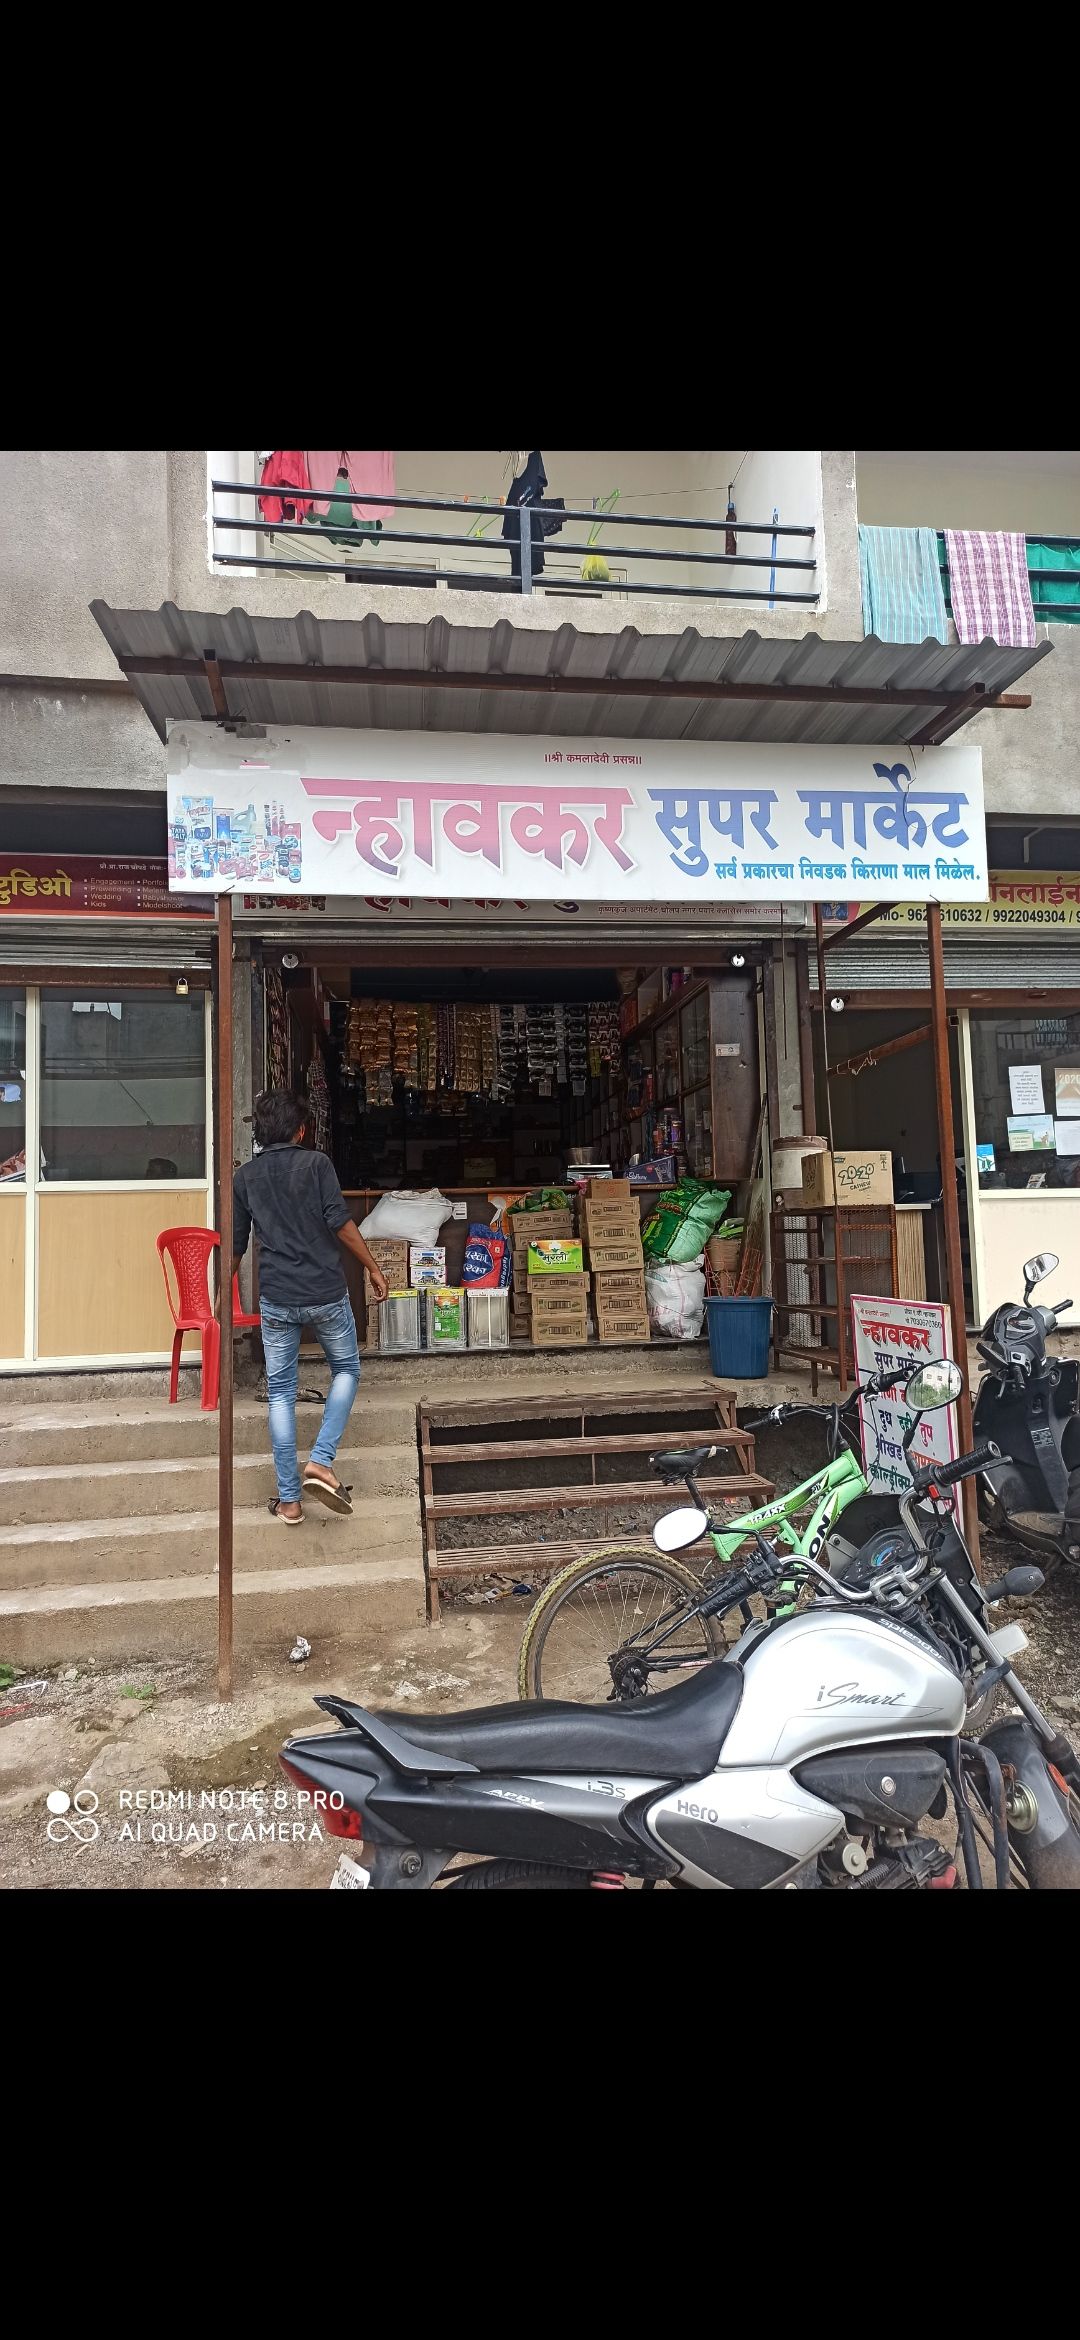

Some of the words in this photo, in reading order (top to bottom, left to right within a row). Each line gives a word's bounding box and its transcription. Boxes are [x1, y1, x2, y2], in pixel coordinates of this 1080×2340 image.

[566, 752, 609, 764] कमलादेवी
[300, 777, 637, 877] न्हावकर
[647, 788, 779, 877] सुपर
[796, 763, 969, 851] मार्केट
[714, 856, 737, 879] सर्व
[742, 863, 794, 880] प्रकारचा
[799, 857, 847, 880] निवडक
[851, 857, 898, 880] किराणा
[903, 863, 930, 880] माल
[935, 857, 981, 880] मिळेल.
[90, 878, 135, 886] Engagement
[90, 893, 121, 901] Wedding
[908, 908, 982, 922] 962610632
[993, 909, 1066, 923] 9922049304
[838, 1162, 875, 1186] 20-20
[849, 1180, 872, 1191] CASHEW
[860, 1320, 933, 1355] न्हावकर
[873, 1351, 894, 1373] सुपर
